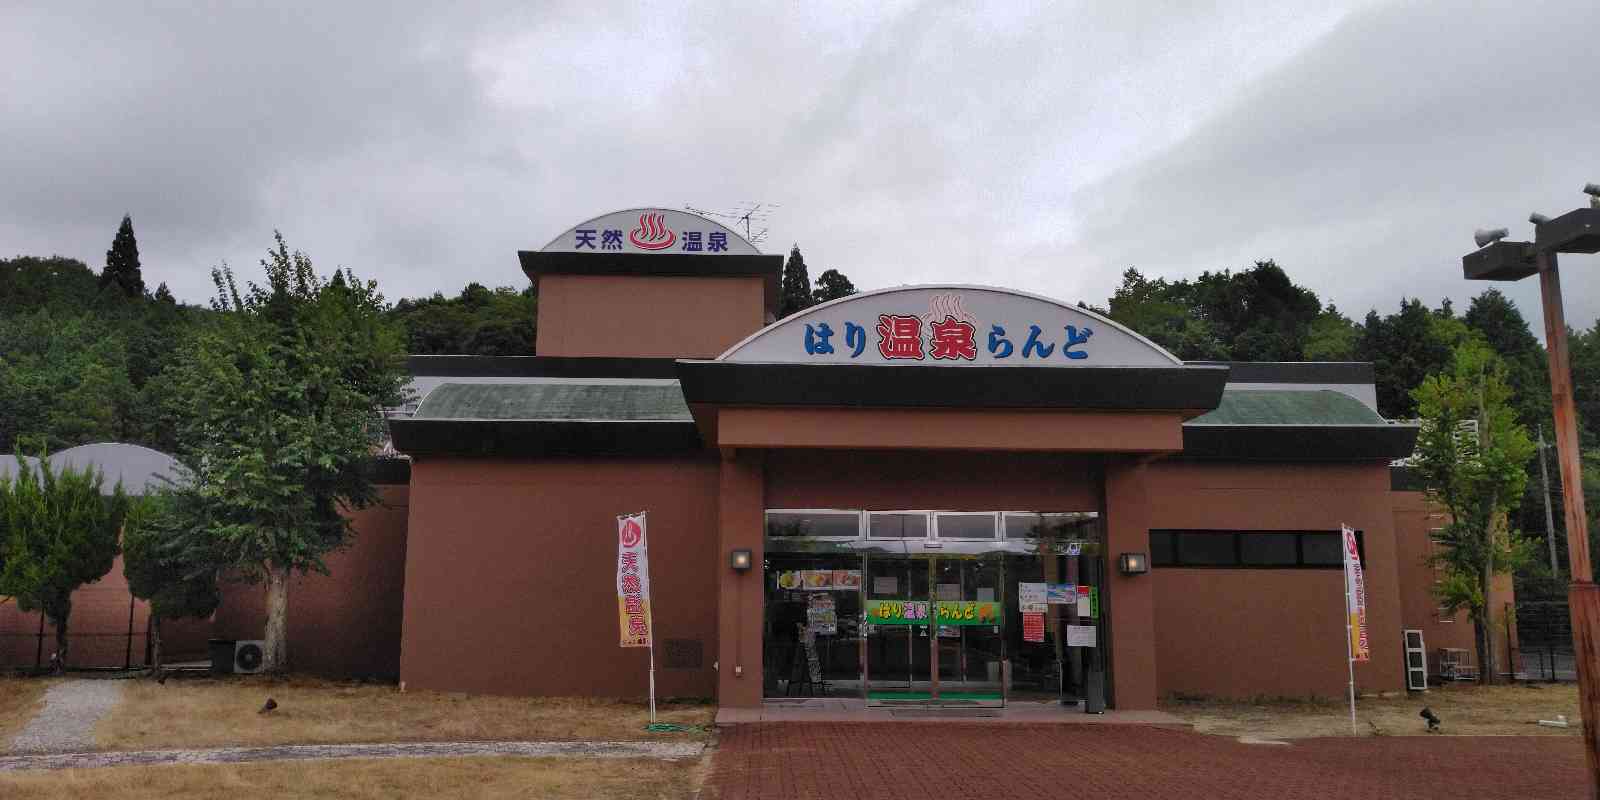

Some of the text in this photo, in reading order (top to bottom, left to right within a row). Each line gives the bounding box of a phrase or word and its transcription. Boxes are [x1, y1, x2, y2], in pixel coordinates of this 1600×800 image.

[575, 229, 729, 252] 天然 温泉
[804, 314, 1094, 361] はり温泉らんど
